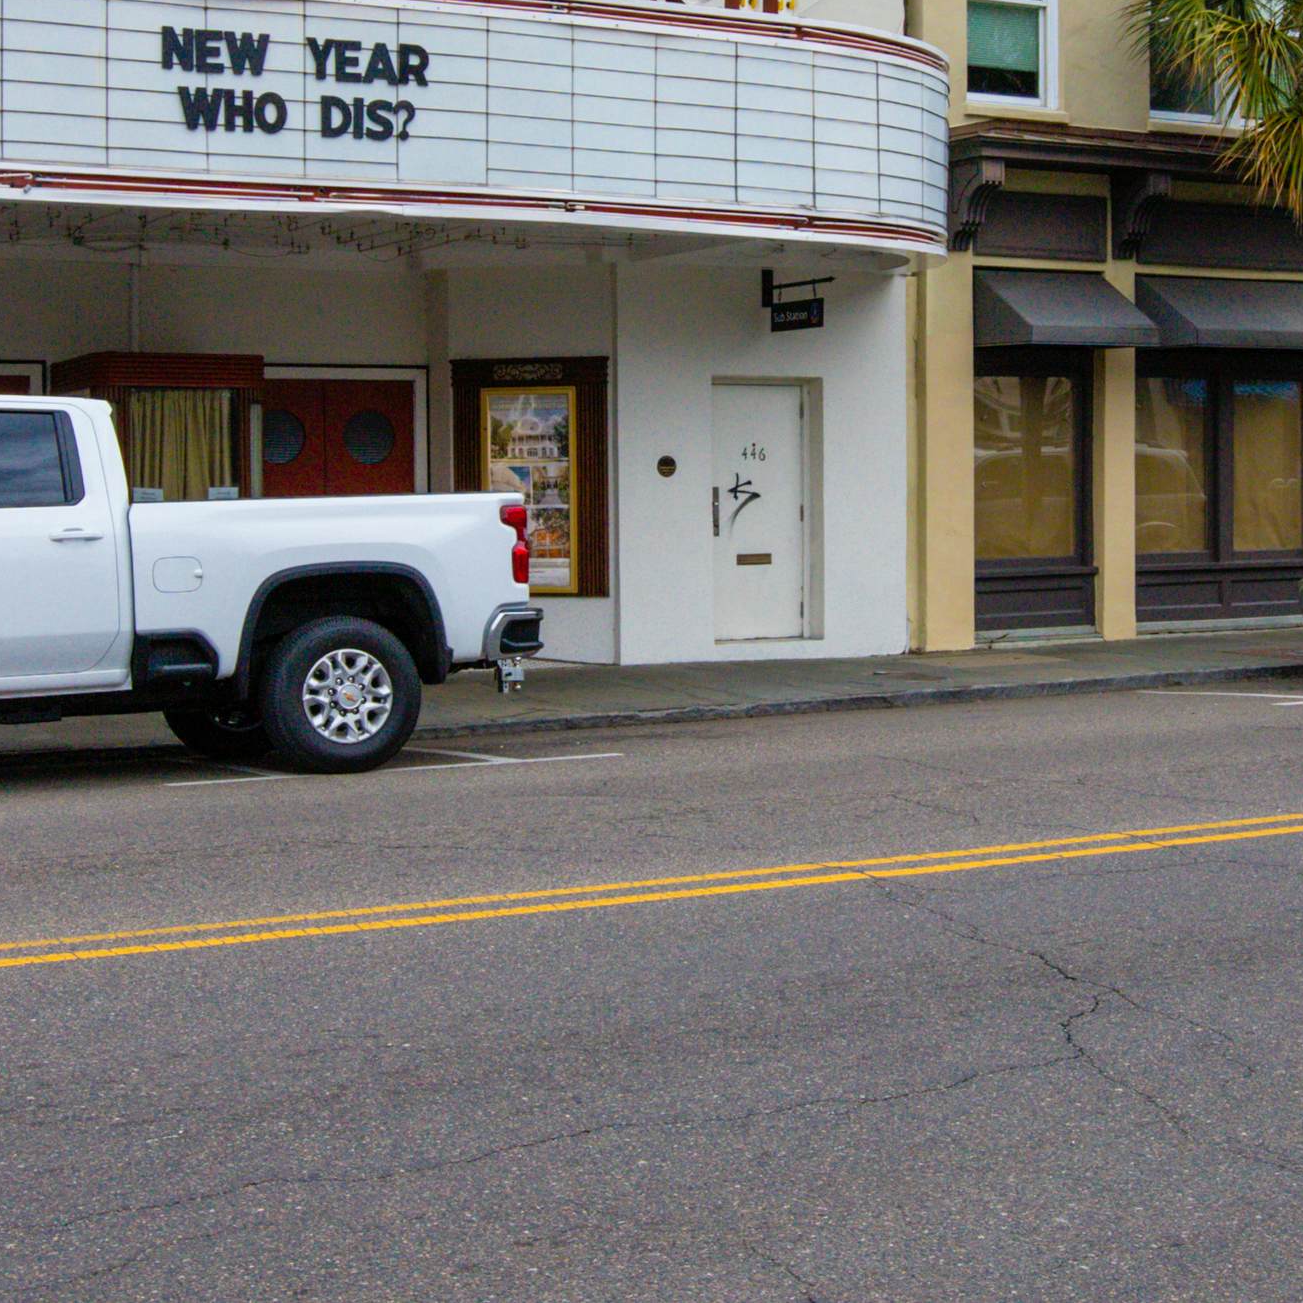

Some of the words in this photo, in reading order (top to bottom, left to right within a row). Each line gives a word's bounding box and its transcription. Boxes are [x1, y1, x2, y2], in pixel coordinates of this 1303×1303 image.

[161, 25, 270, 76] NEW
[306, 36, 430, 87] YEAR
[177, 86, 288, 134] WHO
[320, 95, 416, 141] DIS?
[741, 447, 766, 461] 446
